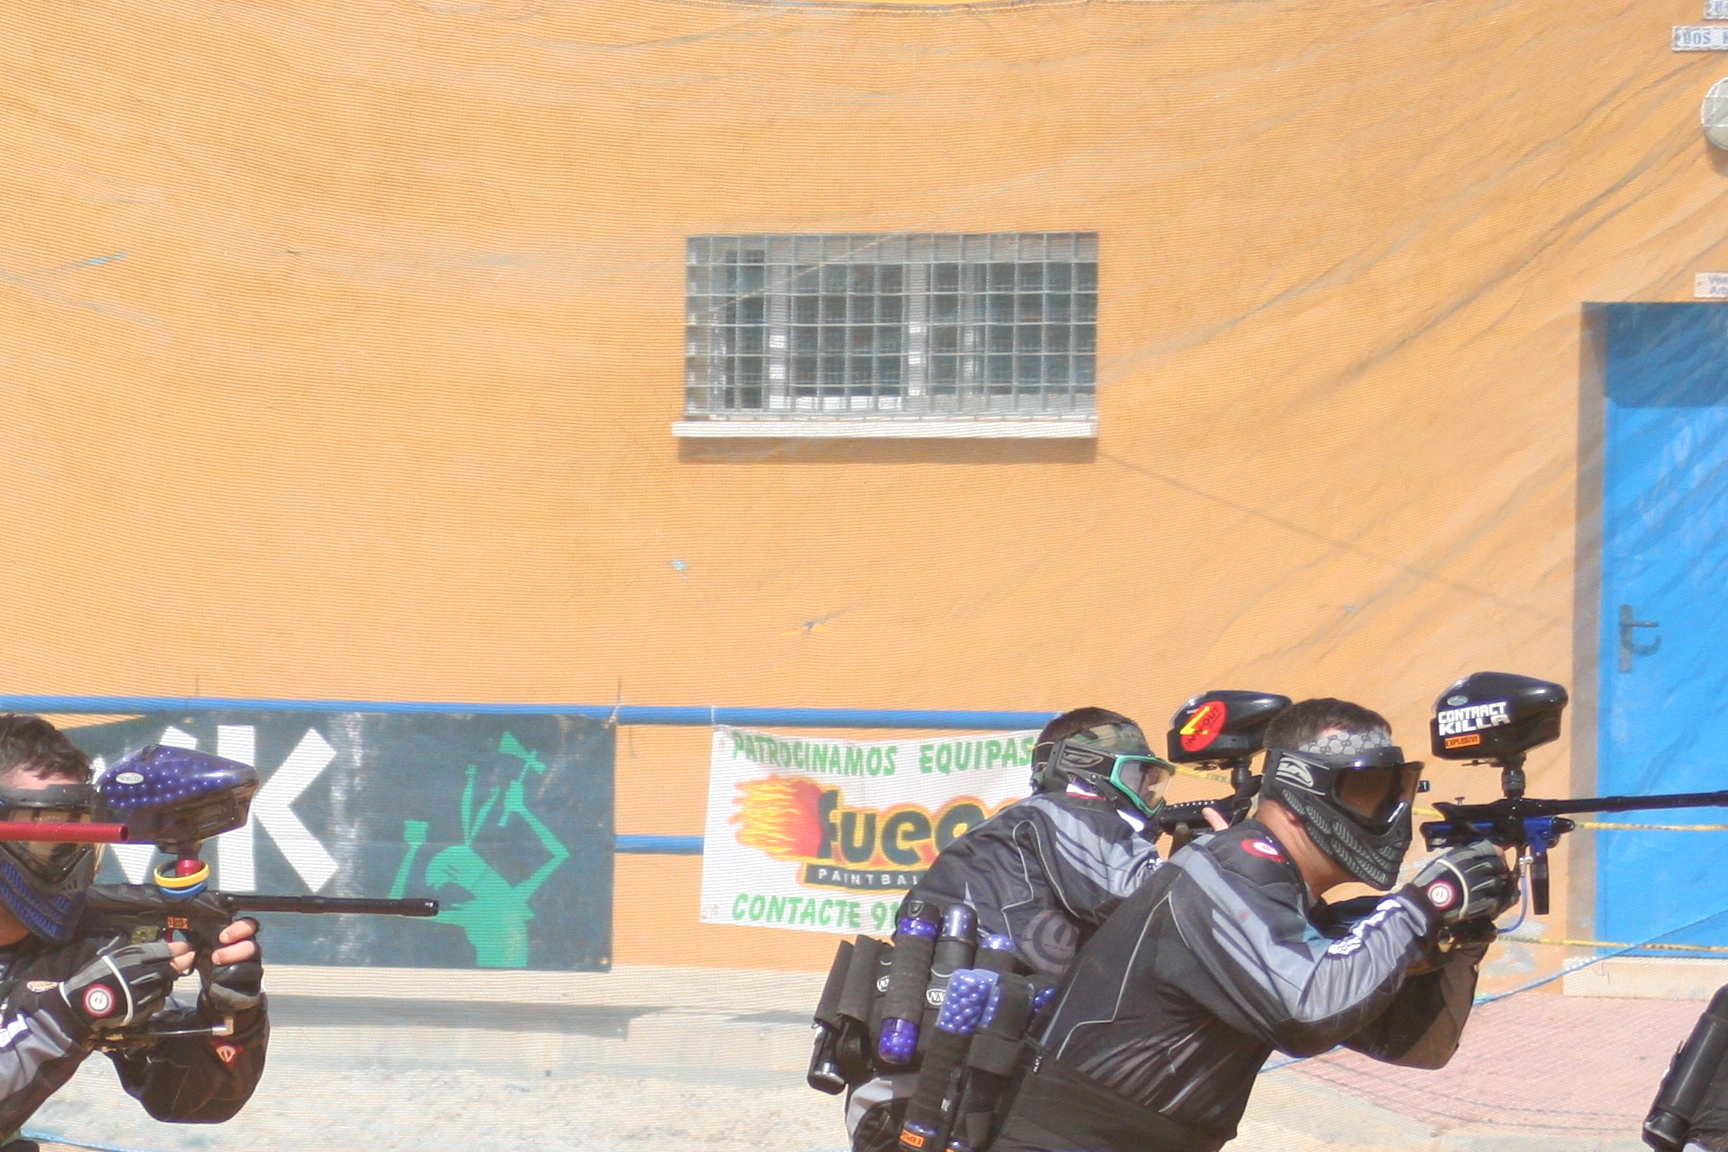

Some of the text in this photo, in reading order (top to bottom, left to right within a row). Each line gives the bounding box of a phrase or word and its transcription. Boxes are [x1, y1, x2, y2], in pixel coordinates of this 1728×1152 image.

[1438, 701, 1507, 724] CONTRACT
[1439, 714, 1511, 736] KILLA
[732, 731, 897, 777] PATROCINAMOS
[817, 868, 919, 886] PAINTBAL
[732, 893, 861, 928] CONTACTE
